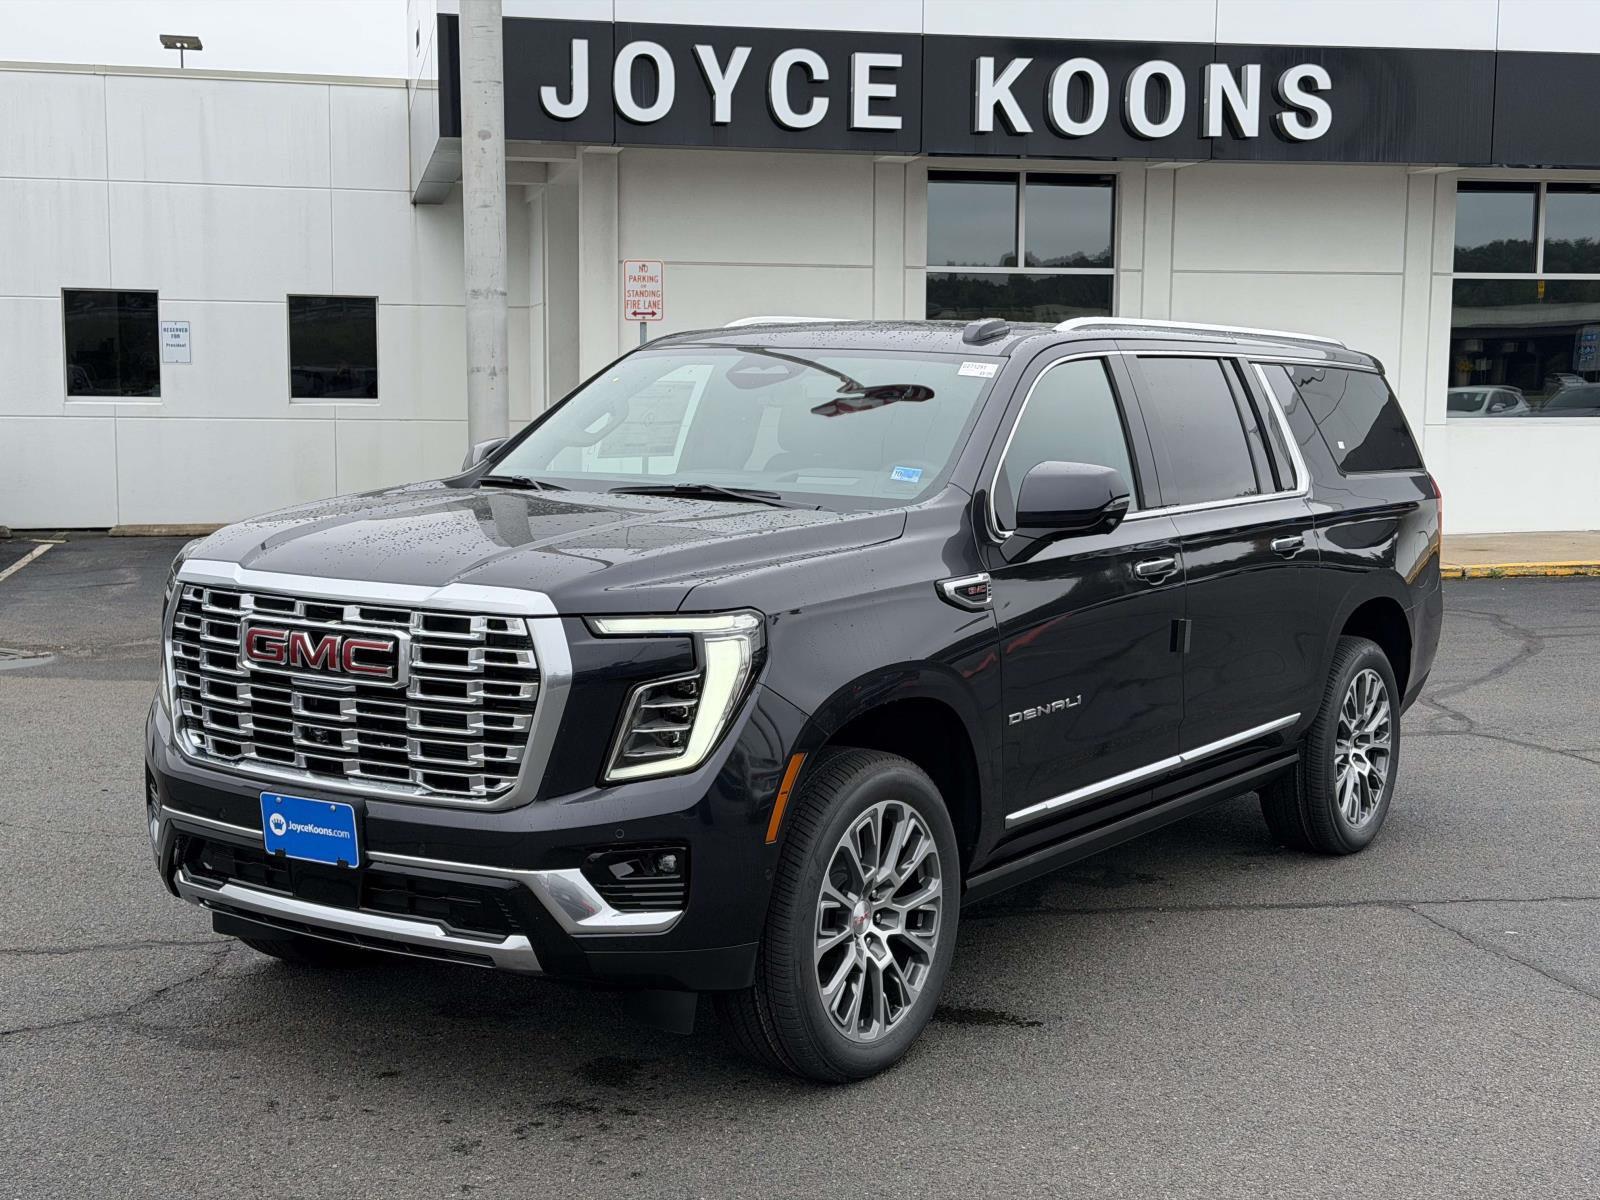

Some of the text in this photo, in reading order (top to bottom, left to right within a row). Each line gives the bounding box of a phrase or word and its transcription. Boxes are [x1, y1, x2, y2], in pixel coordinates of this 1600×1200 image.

[540, 38, 1333, 141] JOYCE KOONS
[638, 264, 649, 273] NO
[628, 275, 659, 283] PARKING
[627, 290, 661, 298] STANDING
[626, 300, 662, 310] FIRE LANE
[246, 626, 394, 679] GMC
[1008, 694, 1082, 726] DENALI
[287, 820, 351, 839] JoyceKoons.com
